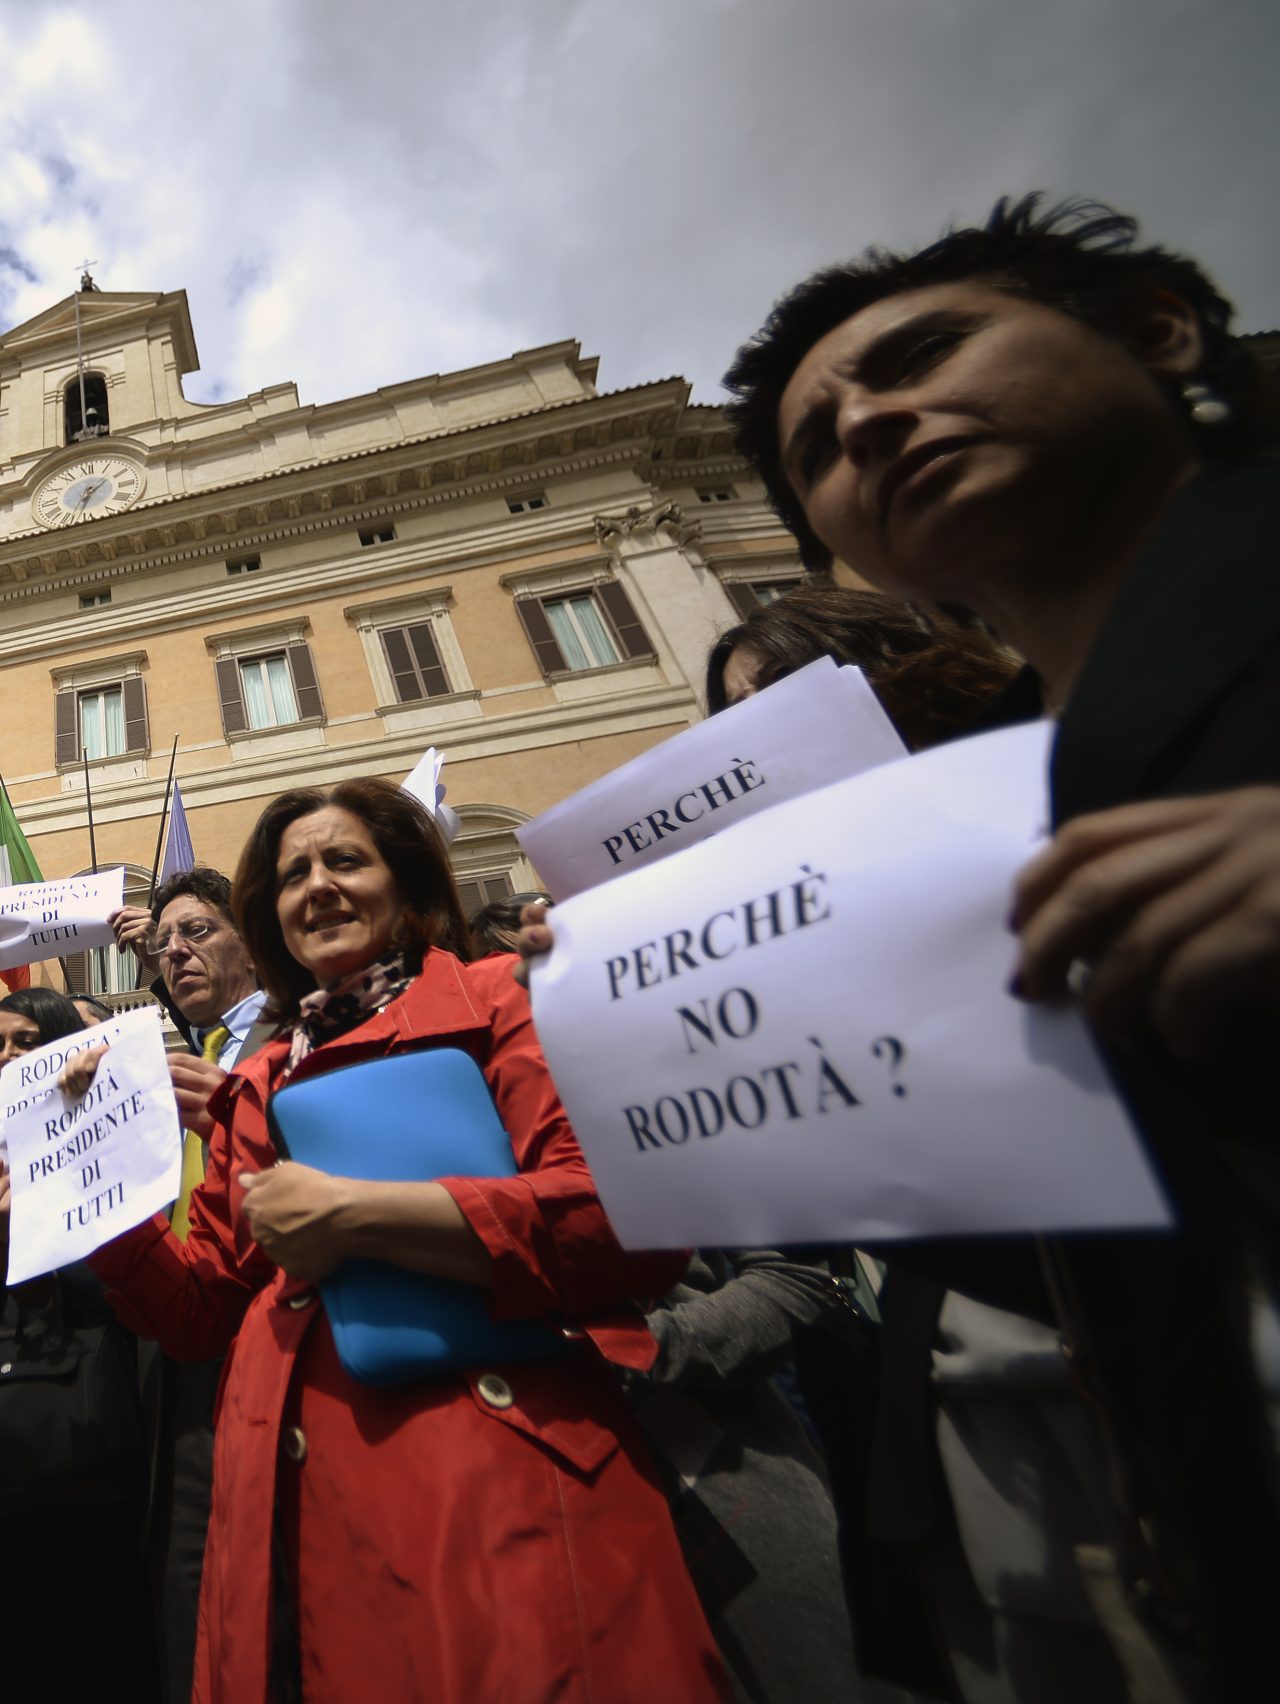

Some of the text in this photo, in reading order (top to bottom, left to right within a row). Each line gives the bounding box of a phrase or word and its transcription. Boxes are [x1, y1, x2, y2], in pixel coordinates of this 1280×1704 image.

[601, 756, 767, 866] PERCHÈ
[28, 923, 79, 946] TUTTI
[42, 909, 59, 924] DI
[604, 864, 833, 1002] PERCHÈ
[676, 986, 761, 1055] NO
[43, 1068, 120, 1142] RODOTÀ
[622, 1034, 910, 1154] RODOTÀ ?
[28, 1090, 146, 1184] PRESIDENTE
[62, 1181, 125, 1233] TUTTI
[81, 1158, 103, 1189] DI
